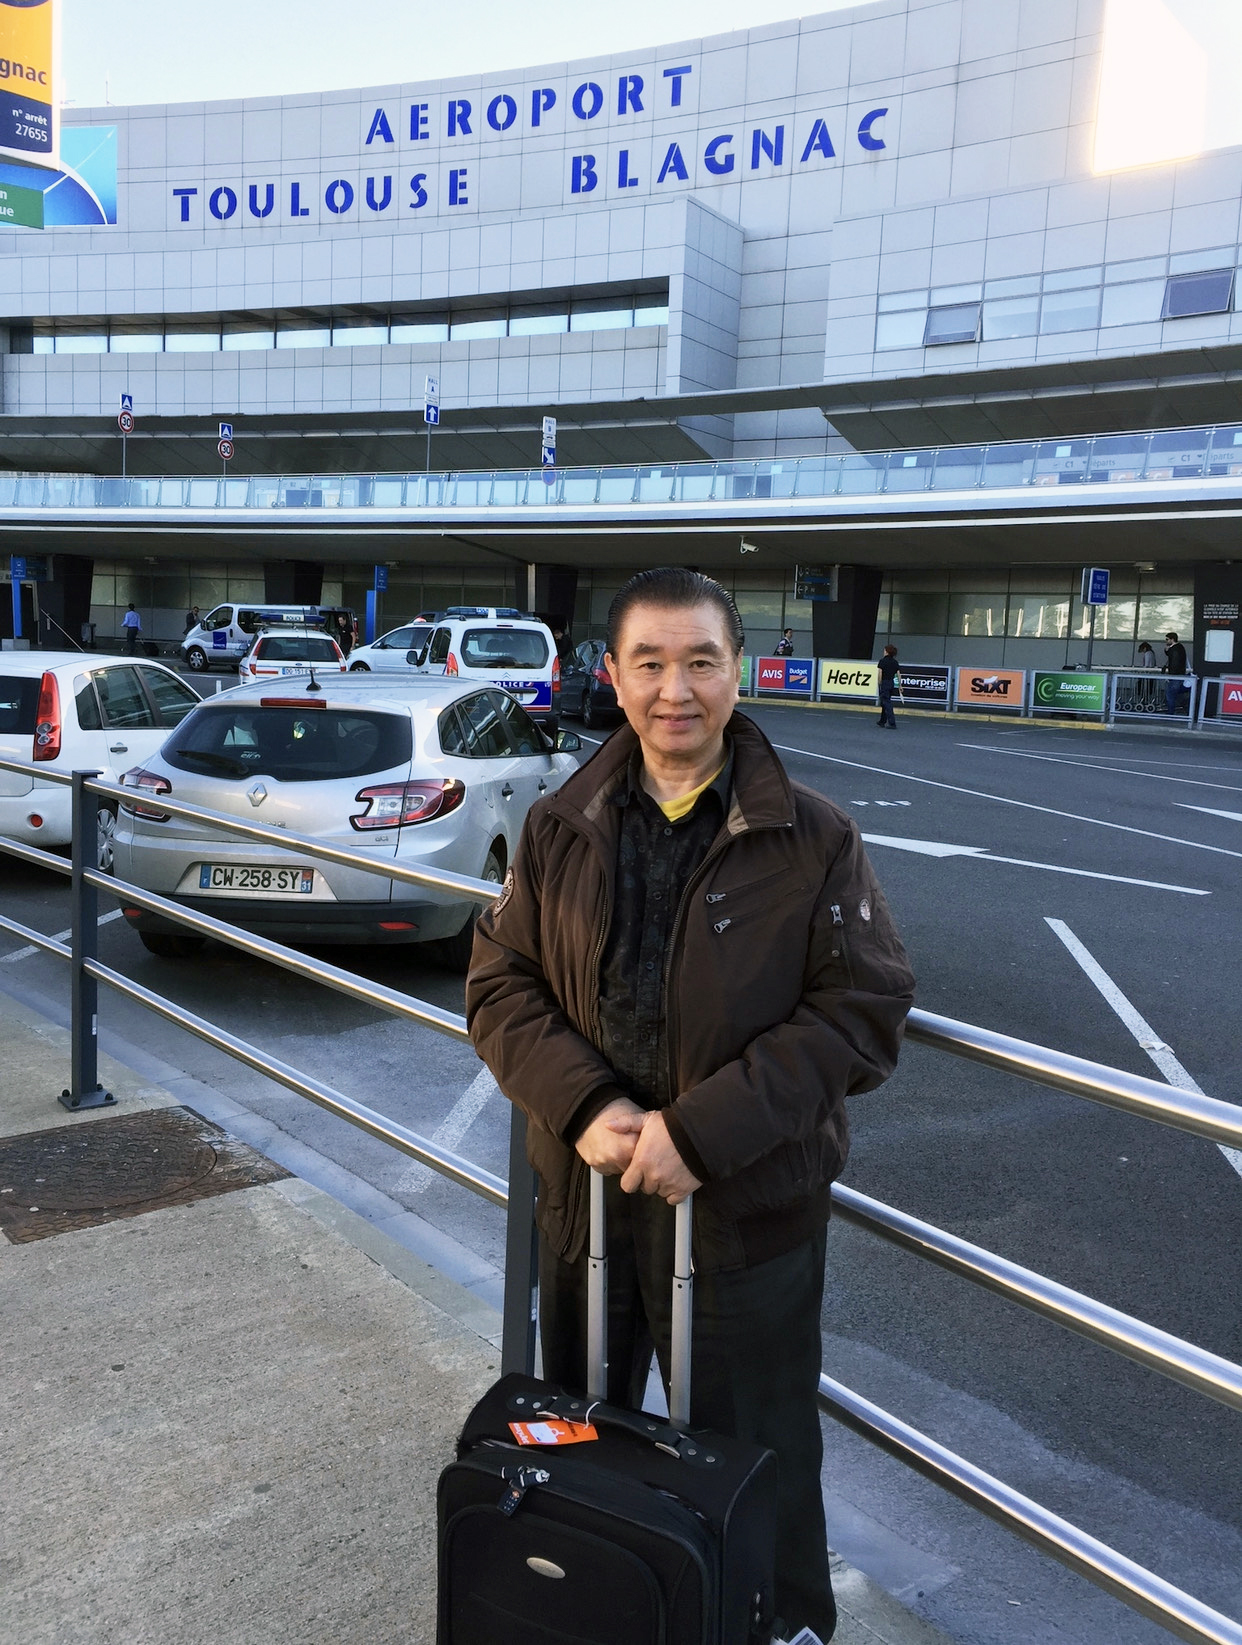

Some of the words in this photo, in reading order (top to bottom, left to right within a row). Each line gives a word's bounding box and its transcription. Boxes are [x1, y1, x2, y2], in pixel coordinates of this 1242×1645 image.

[0, 58, 47, 85] gnac
[365, 65, 692, 145] AEROPORT
[25, 112, 47, 126] arrêt
[15, 123, 48, 142] 27655
[173, 168, 469, 222] TOULOUSE
[571, 107, 889, 194] BLAGNAC
[122, 417, 131, 428] 30
[222, 445, 231, 455] 30
[761, 669, 783, 679] AVIS
[789, 668, 808, 676] Budget
[827, 669, 872, 687] Hertz
[1060, 682, 1097, 692] Europcar
[301, 881, 311, 891] 31
